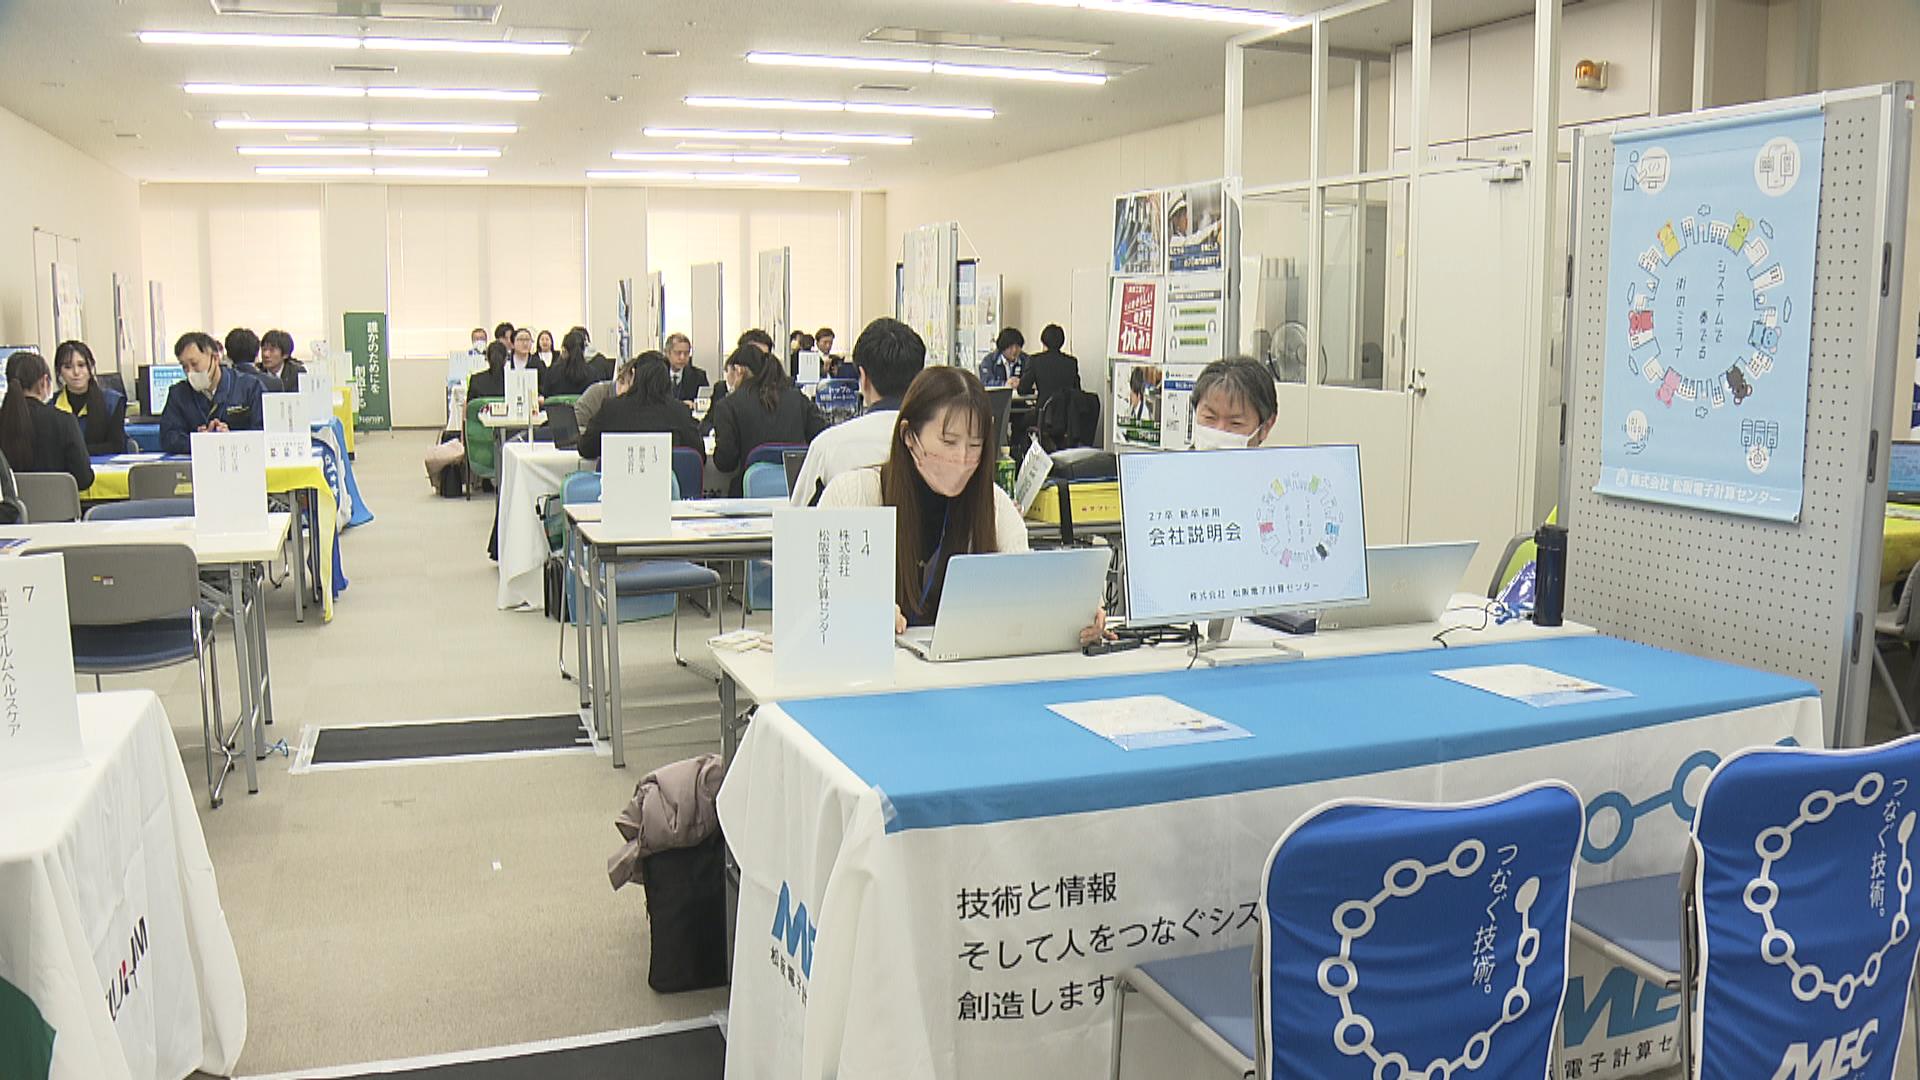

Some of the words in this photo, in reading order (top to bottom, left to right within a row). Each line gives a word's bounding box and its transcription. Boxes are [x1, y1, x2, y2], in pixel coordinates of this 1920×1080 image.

[1674, 275, 1687, 359] 街のミライ
[1714, 259, 1727, 343] システムで
[1698, 310, 1709, 360] 奏でる
[1630, 472, 1669, 492] 株式会社
[1672, 479, 1781, 504] 松阪電子計算センター
[839, 528, 851, 577] 株式会社
[861, 529, 870, 556] 14
[1149, 522, 1241, 547] 会社説明会
[22, 586, 35, 602] 7
[818, 528, 830, 645] 松阪電子計算センター
[1190, 589, 1225, 601] 株式会社
[1232, 581, 1320, 599] 松阪電子計算センター
[957, 872, 1118, 920] 技術と情報
[958, 901, 1260, 971] そして人をつなぐシス
[957, 974, 1116, 1021] 創造します
[1770, 1018, 1879, 1080] MEC
